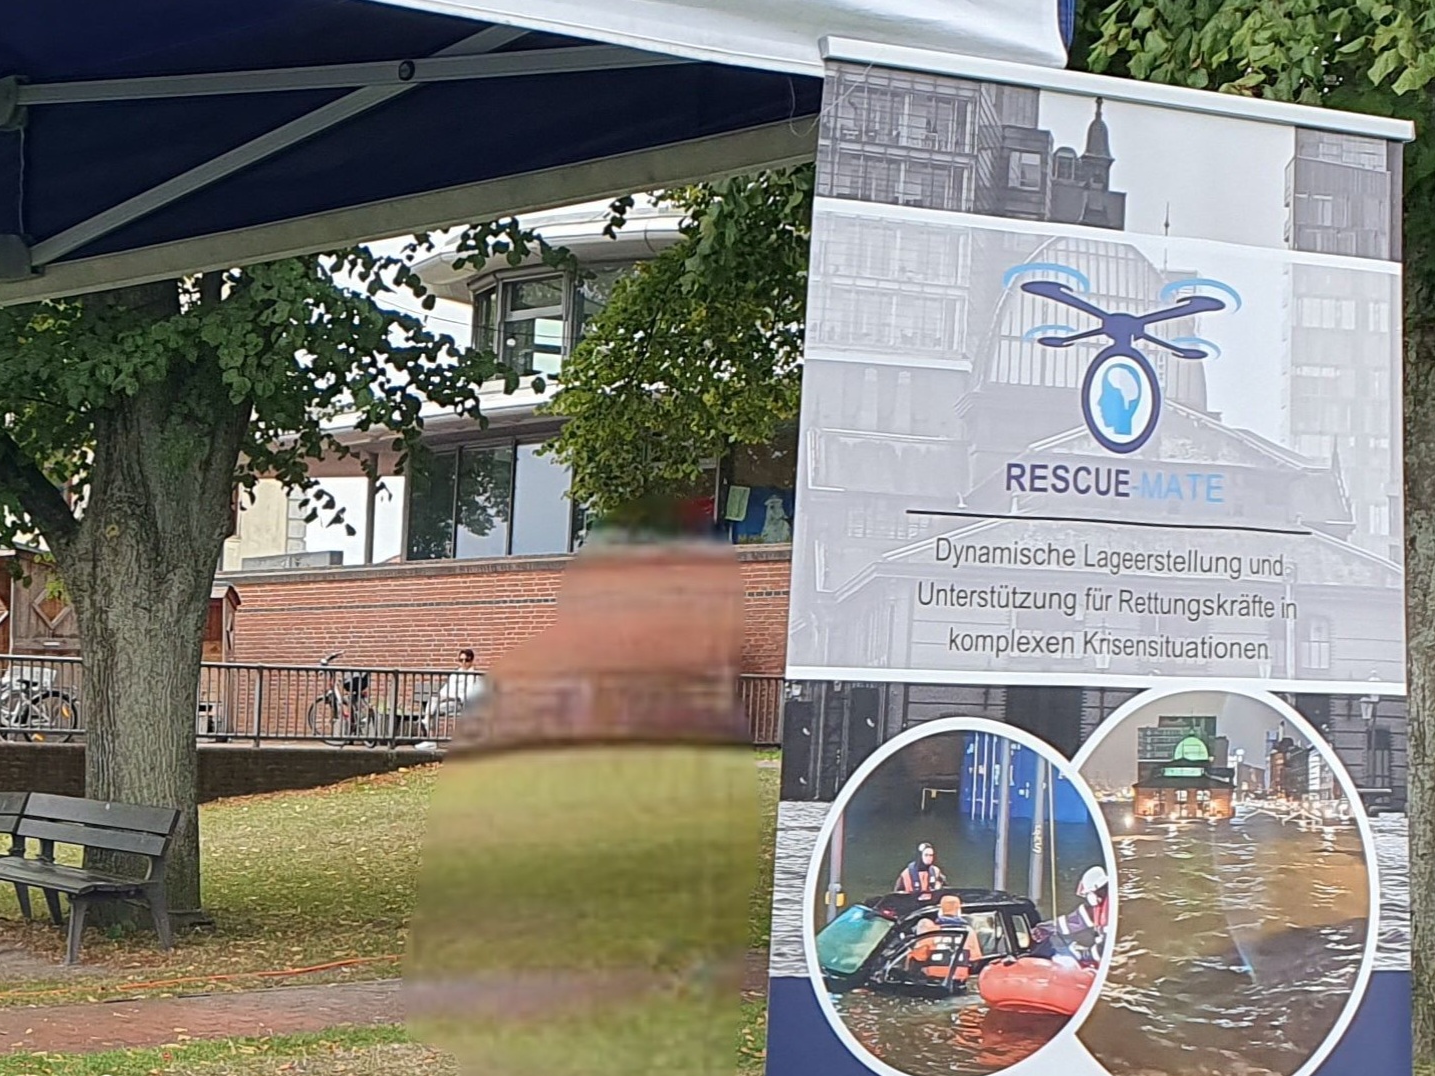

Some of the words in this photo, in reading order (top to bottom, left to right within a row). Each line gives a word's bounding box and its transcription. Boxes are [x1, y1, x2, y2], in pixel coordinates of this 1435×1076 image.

[1004, 462, 1224, 503] RESCUE-MATE
[934, 538, 1076, 569] Dynamische
[1082, 541, 1241, 579] Lageerstellung
[1248, 553, 1284, 578] und
[916, 580, 1077, 618] Unterstützung
[1084, 585, 1112, 612] für
[1118, 588, 1276, 622] Rettungskräfte
[1280, 596, 1297, 620] in
[948, 628, 1075, 660] komplexen
[1082, 632, 1269, 661] Krisensituationen
